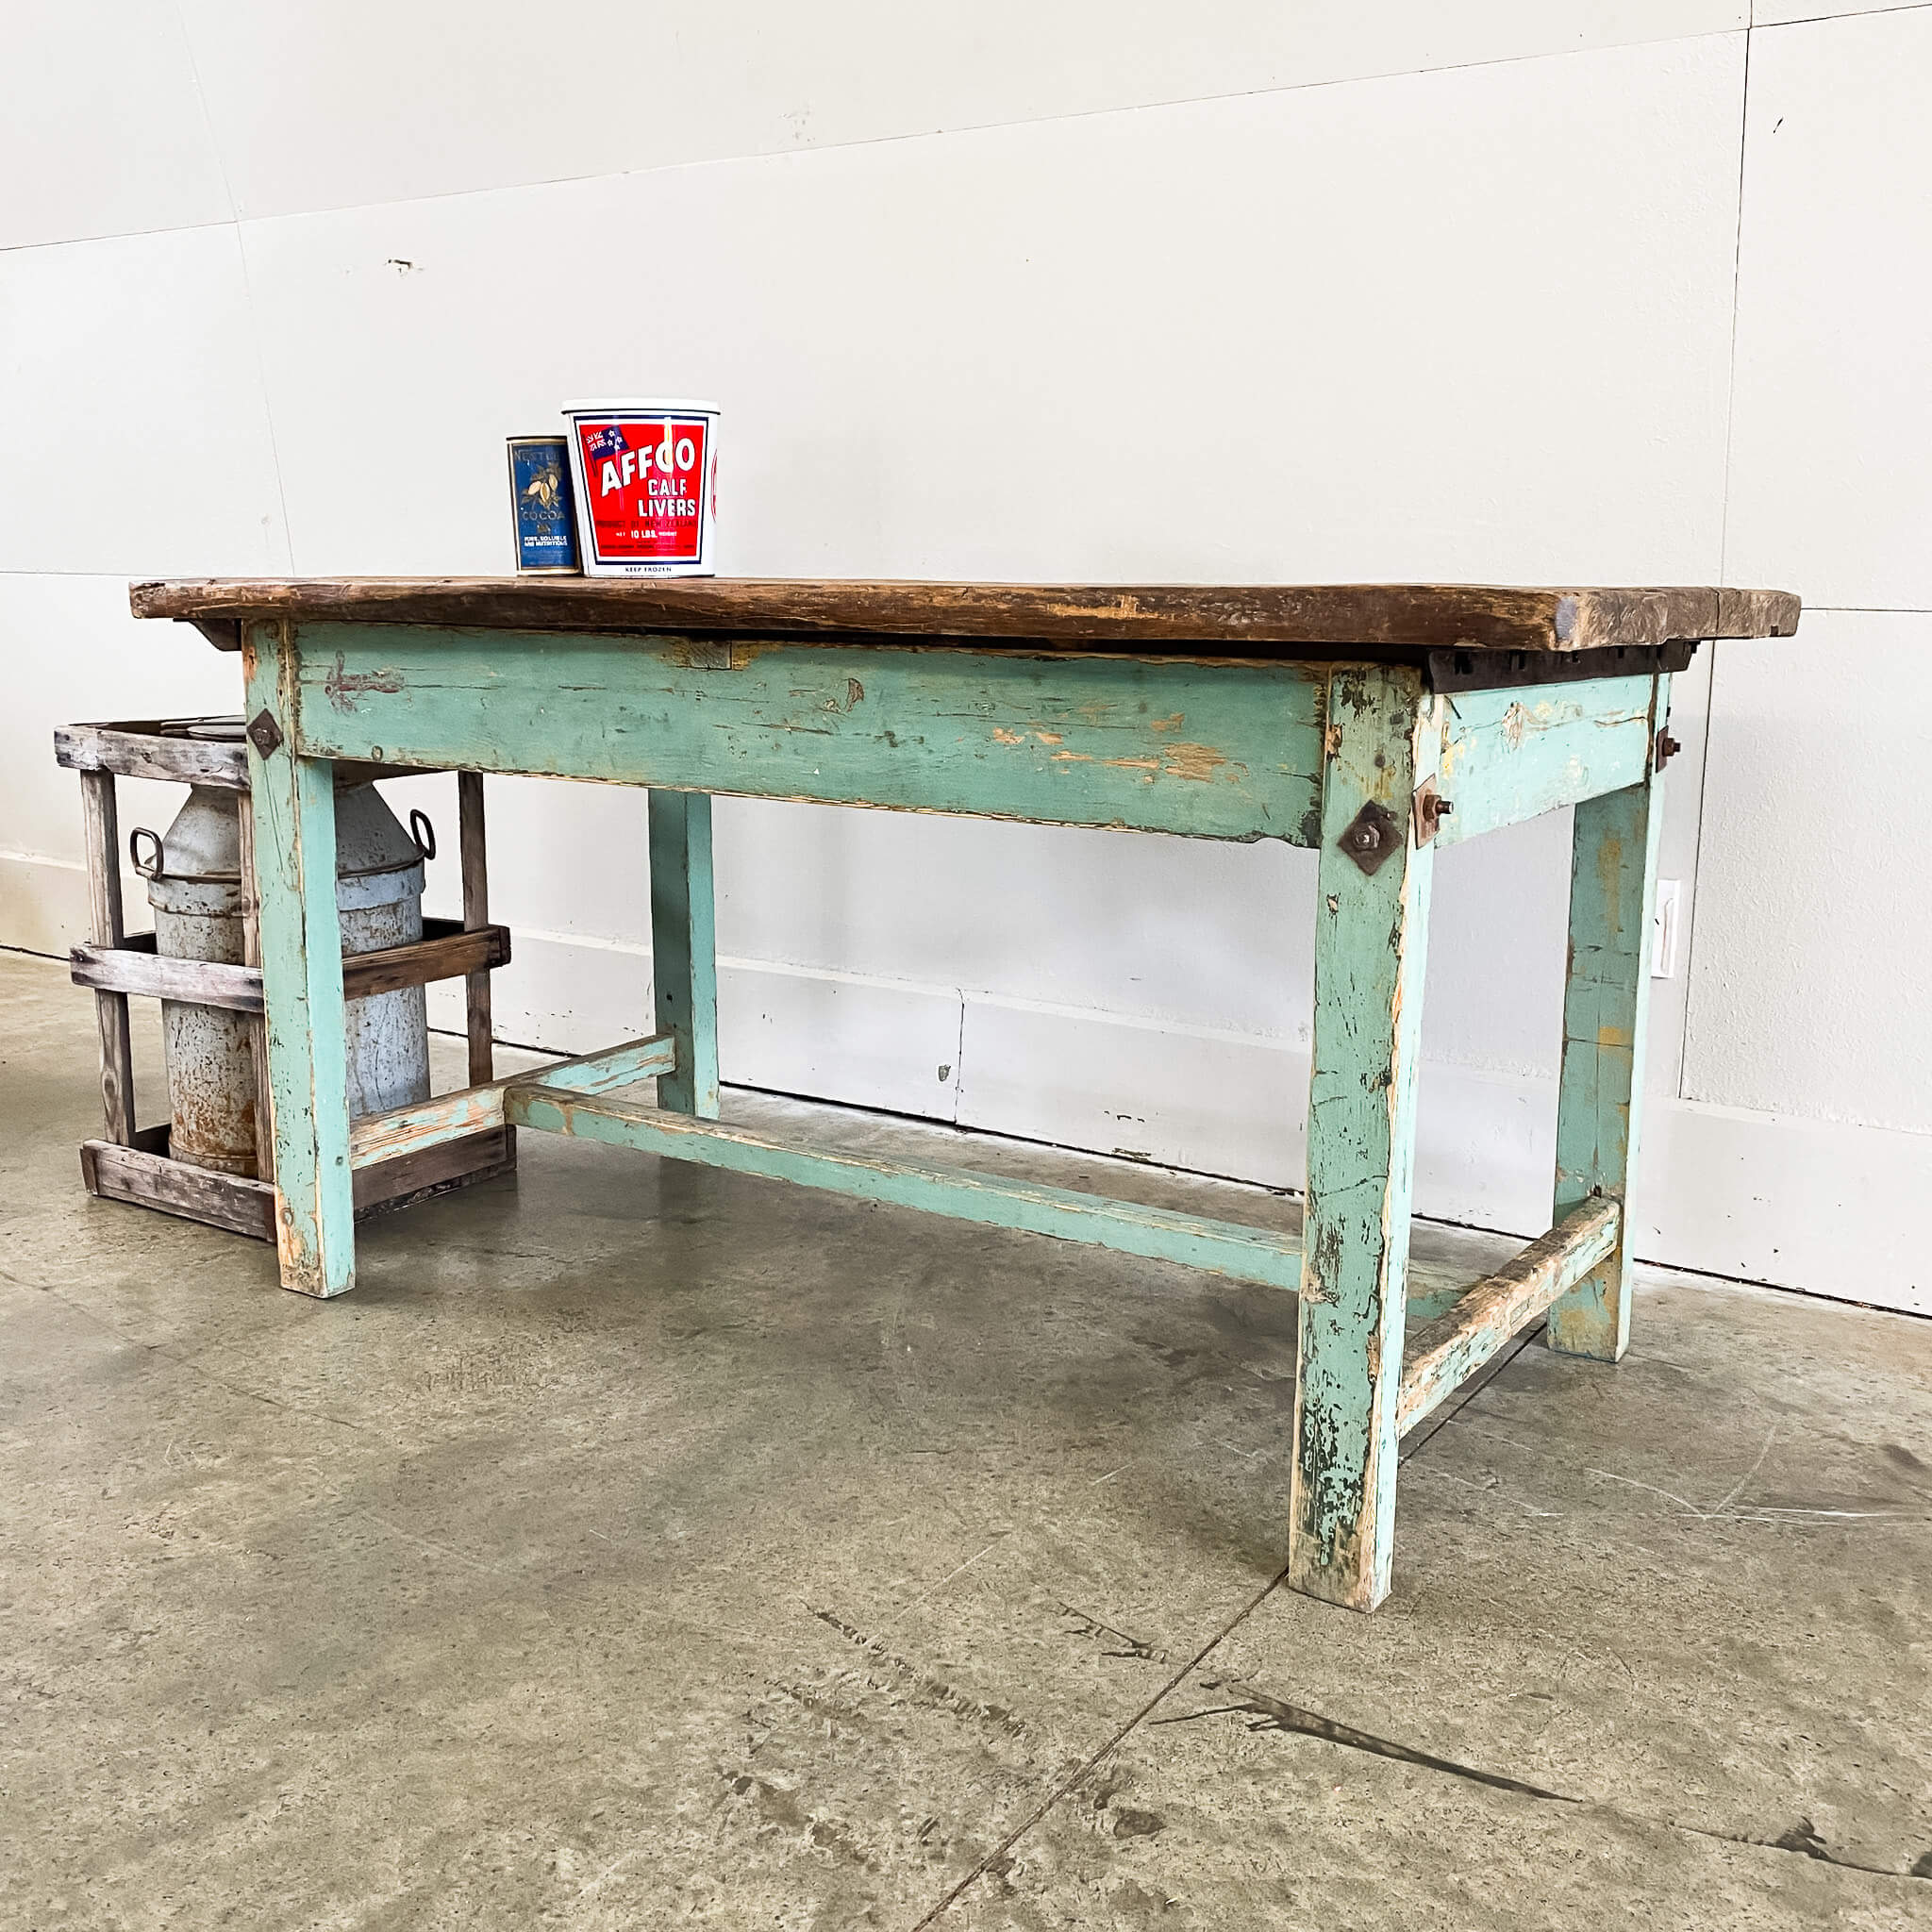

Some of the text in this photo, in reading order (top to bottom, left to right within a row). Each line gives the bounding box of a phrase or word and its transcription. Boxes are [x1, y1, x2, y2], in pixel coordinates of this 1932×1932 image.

[601, 438, 695, 498] AFFCO
[648, 478, 687, 496] CALF
[523, 510, 565, 521] COCOA
[639, 499, 696, 517] LIVERS
[630, 529, 640, 539] 10
